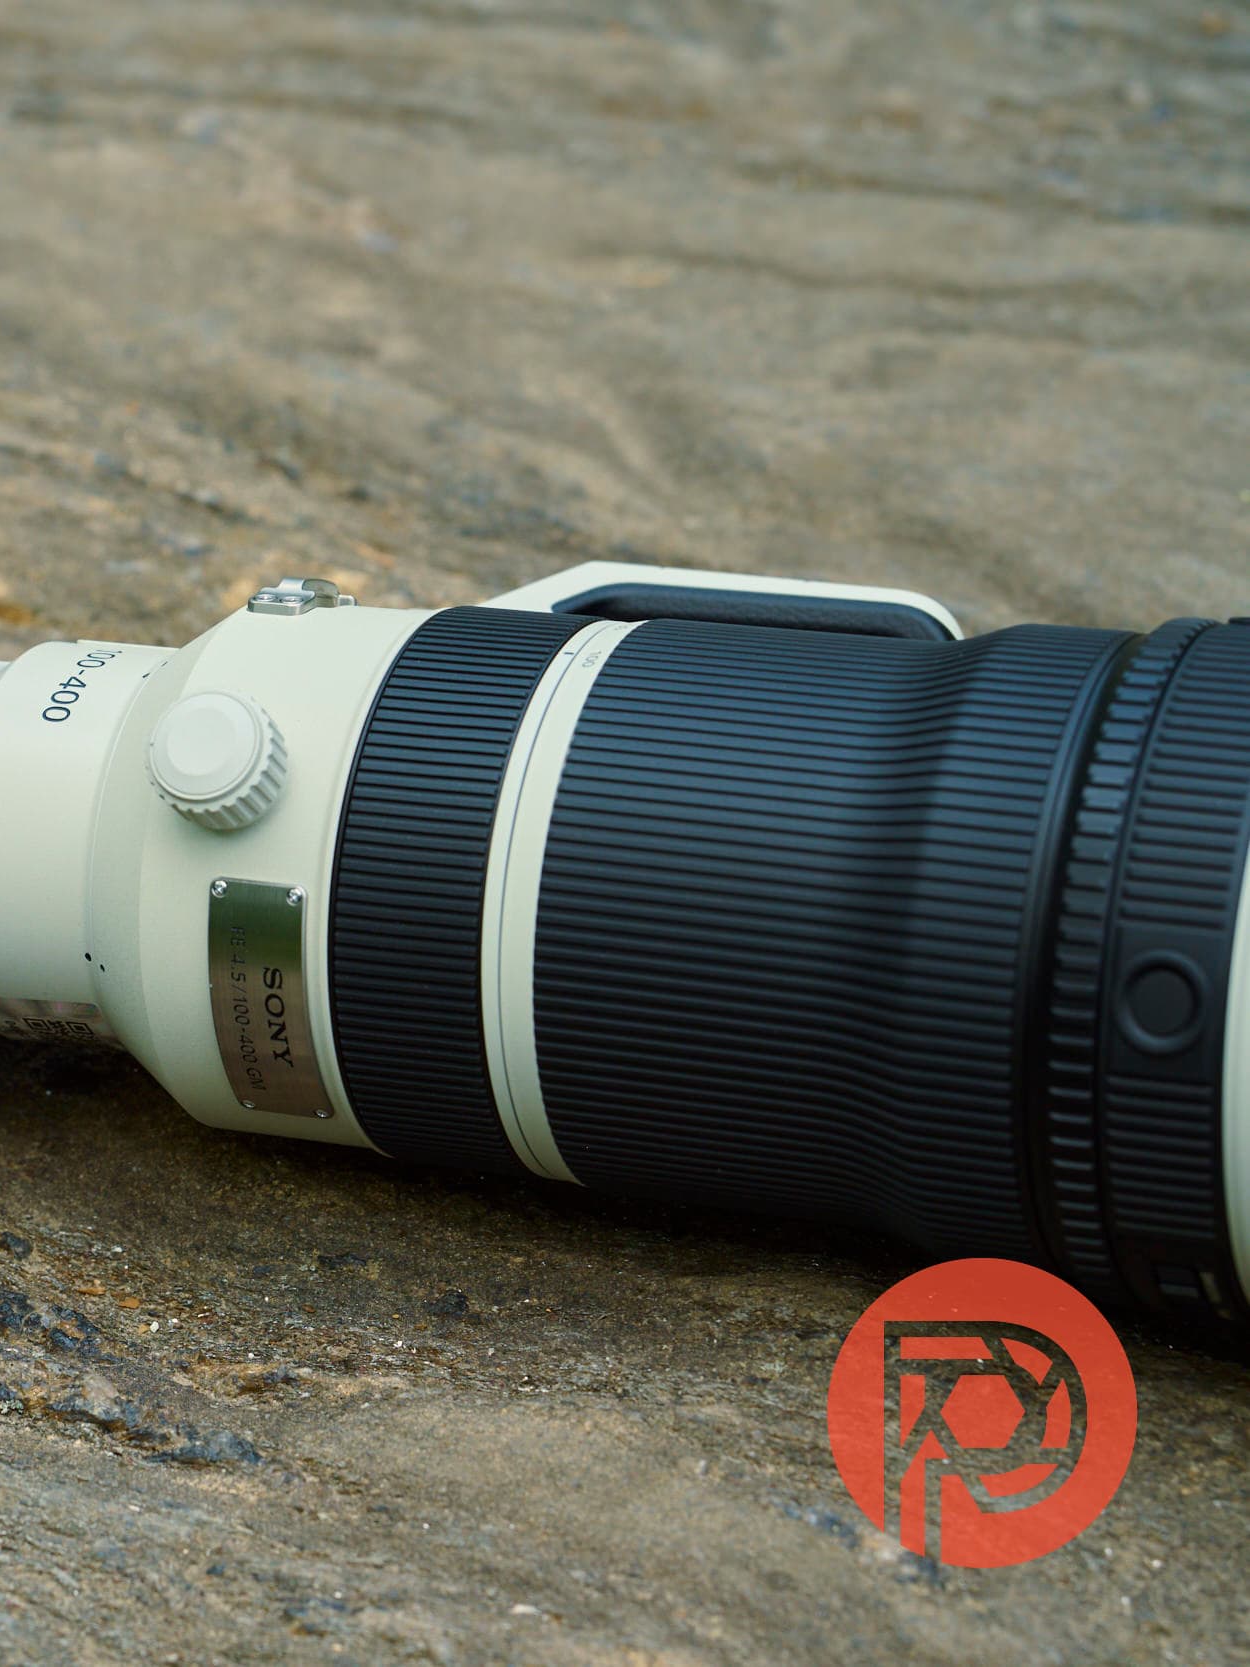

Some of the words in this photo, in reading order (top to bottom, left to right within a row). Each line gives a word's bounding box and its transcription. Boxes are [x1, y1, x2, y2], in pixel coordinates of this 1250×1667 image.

[42, 649, 123, 723] 100-400
[230, 926, 247, 947] FE
[246, 1064, 267, 1092] GM
[262, 966, 294, 1069] SONY
